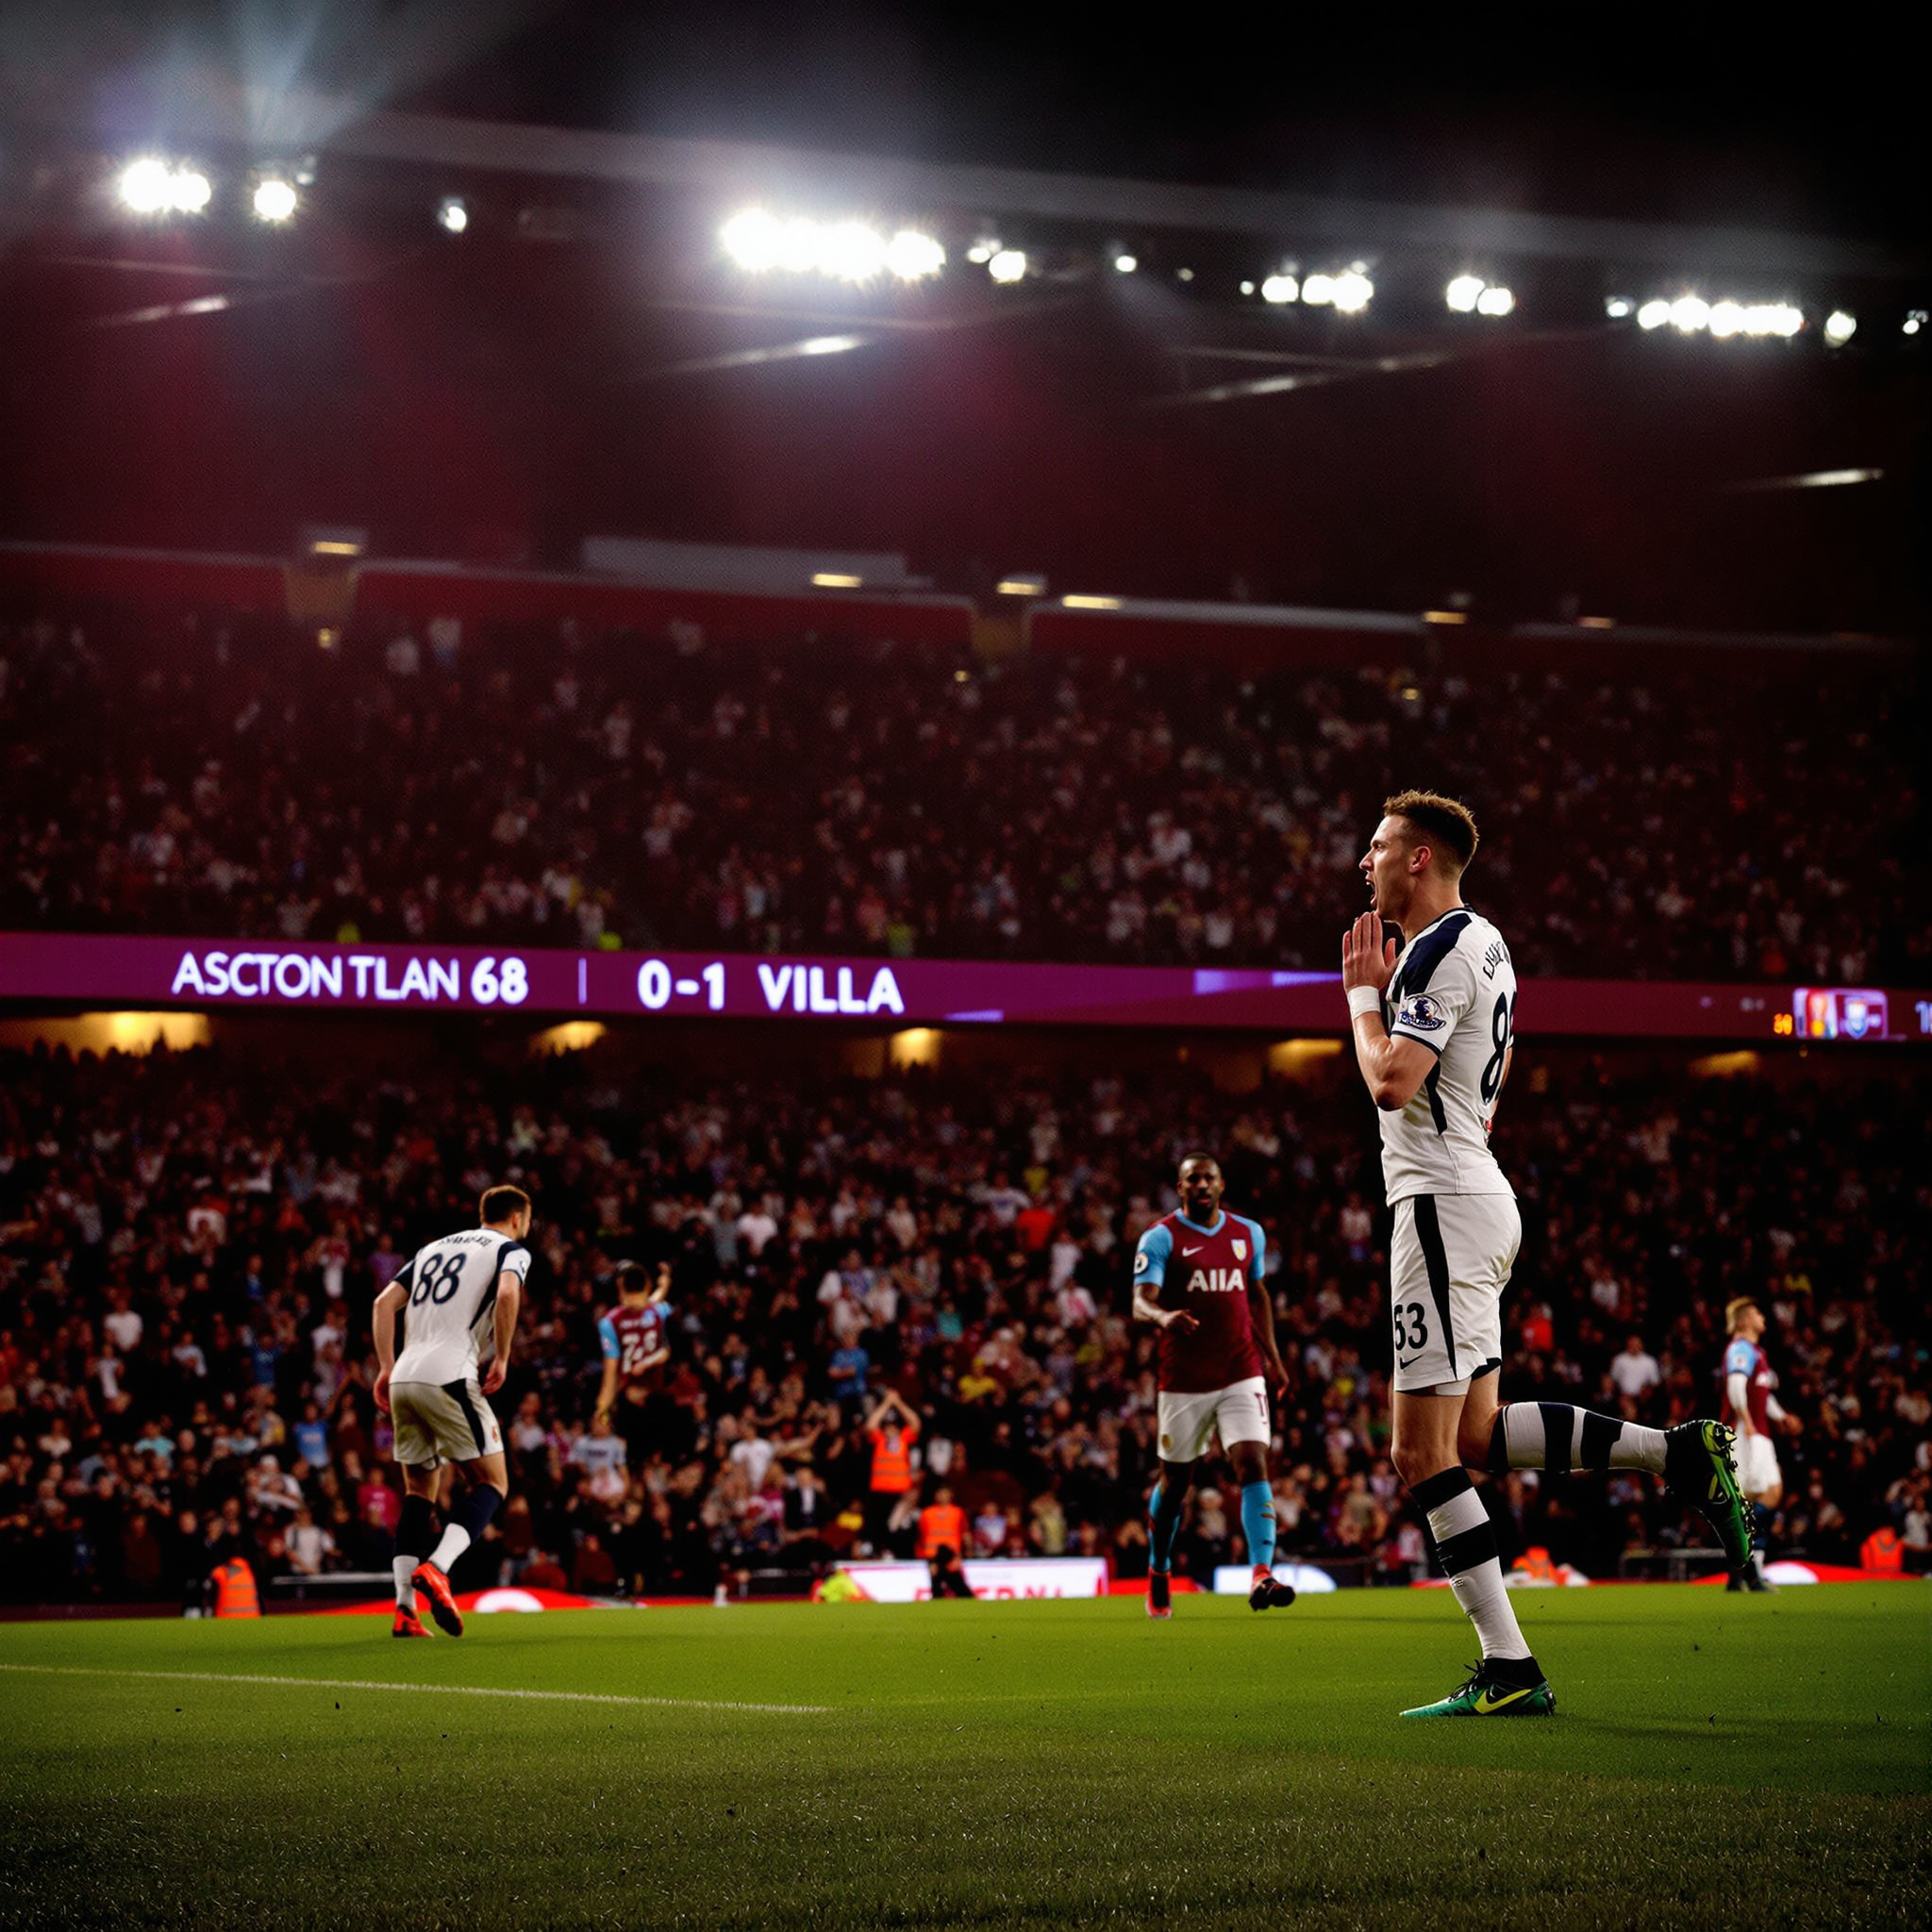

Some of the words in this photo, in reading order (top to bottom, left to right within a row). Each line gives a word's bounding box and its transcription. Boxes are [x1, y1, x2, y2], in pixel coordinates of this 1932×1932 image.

[471, 956, 529, 1005] 68
[637, 958, 724, 1010] 0-1
[758, 962, 905, 1014] VILLA
[1480, 991, 1517, 1107] 8
[412, 1252, 467, 1307] 88
